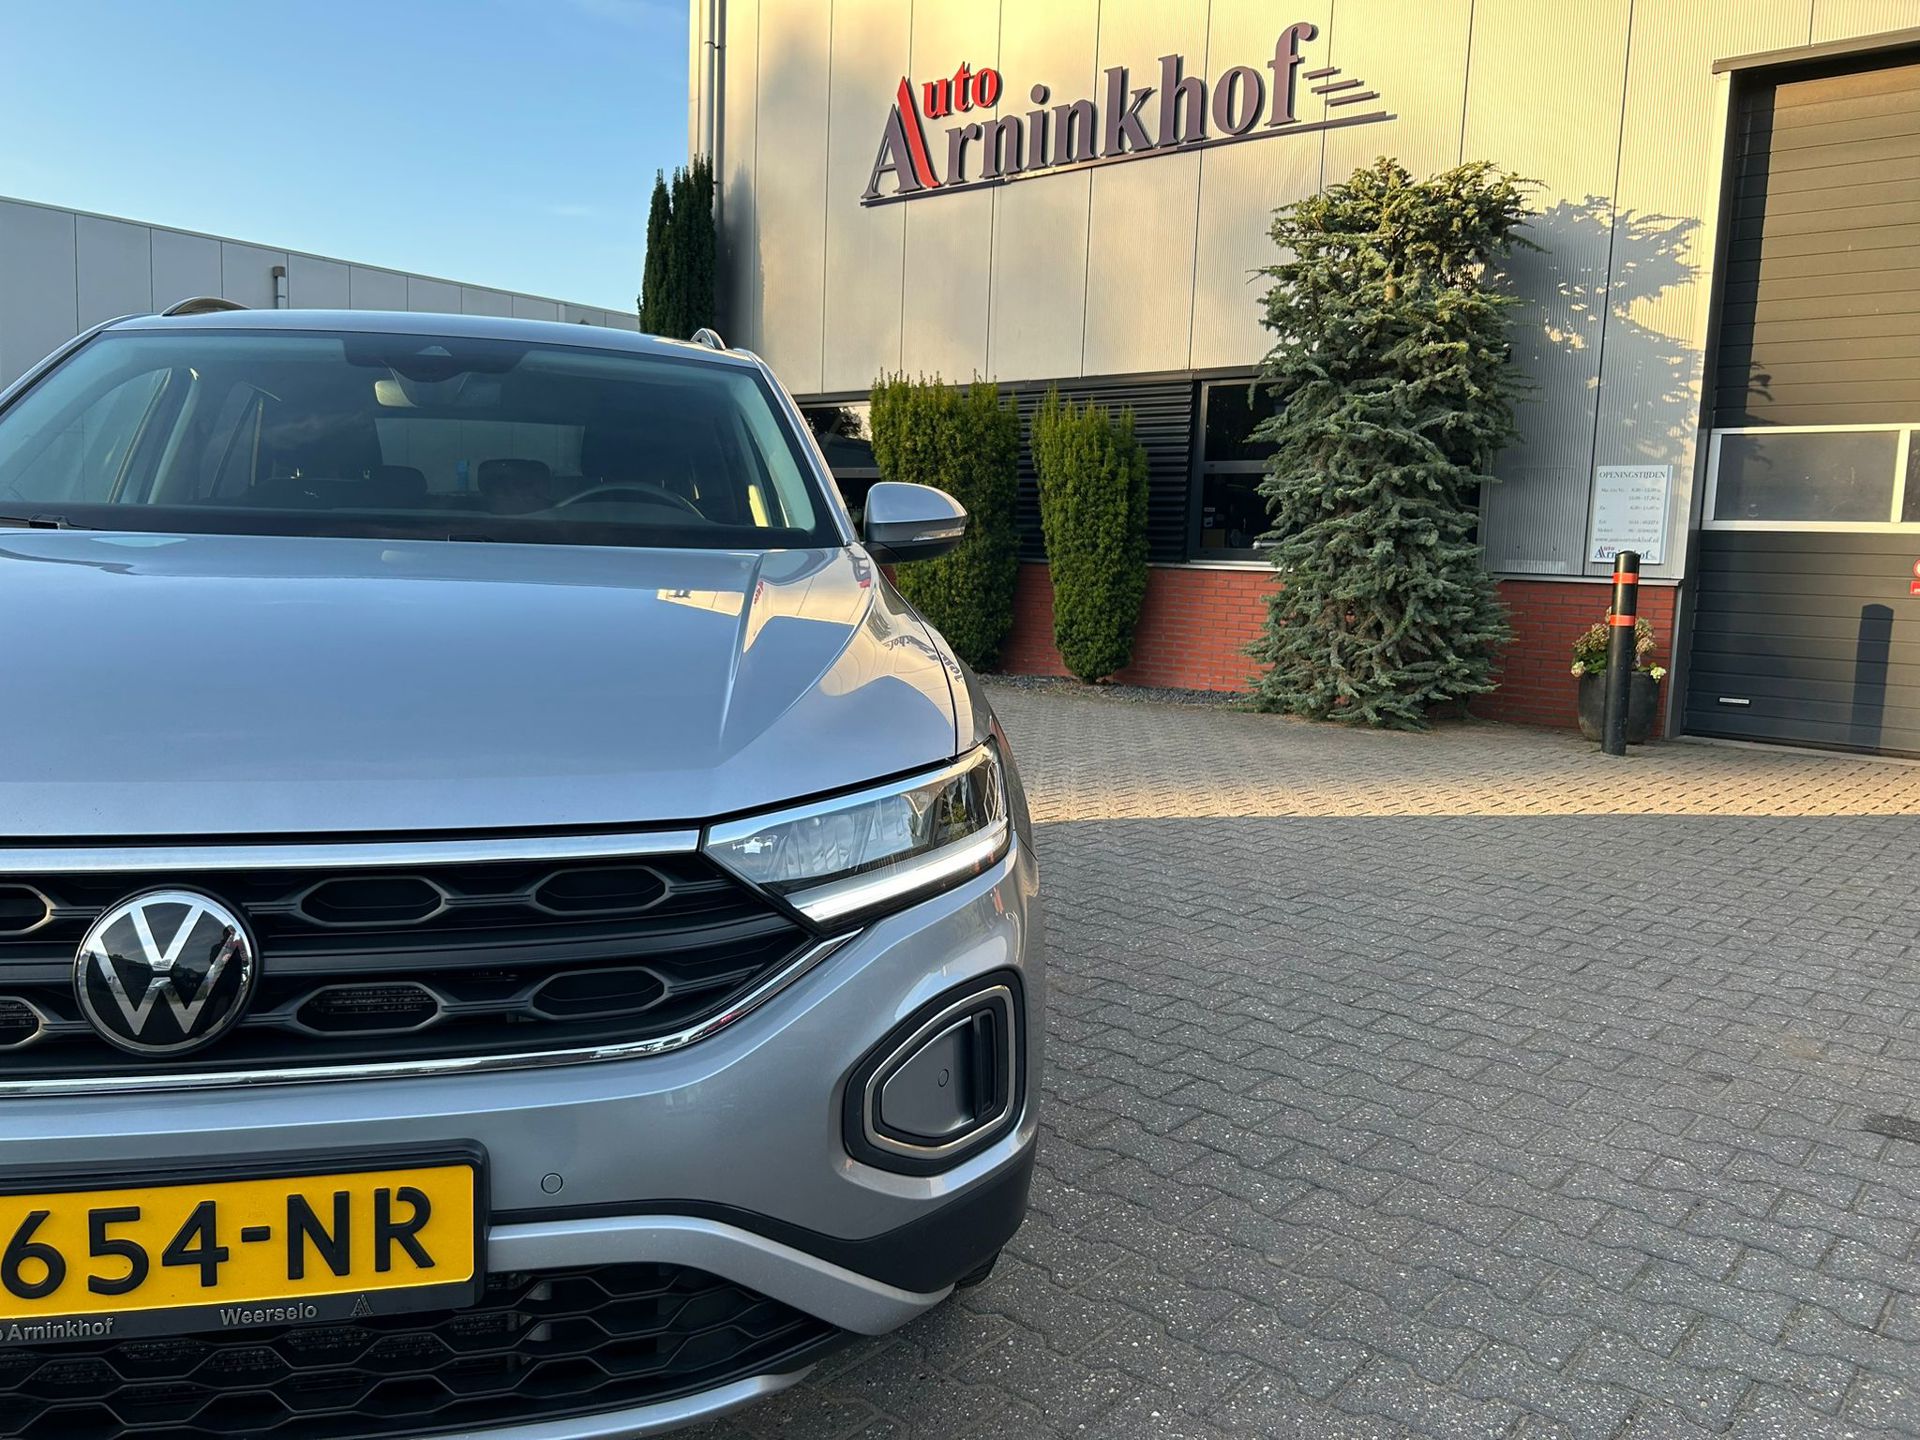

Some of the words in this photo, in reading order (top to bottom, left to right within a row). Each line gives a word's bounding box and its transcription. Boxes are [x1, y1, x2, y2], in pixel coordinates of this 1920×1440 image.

[861, 22, 1319, 199] Arninkhof
[1598, 471, 1666, 479] OPENINGSTIJDEN
[0, 1186, 436, 1300] 654-NR
[219, 1302, 318, 1327] Weerselo
[7, 1317, 114, 1341] Arninkhof
